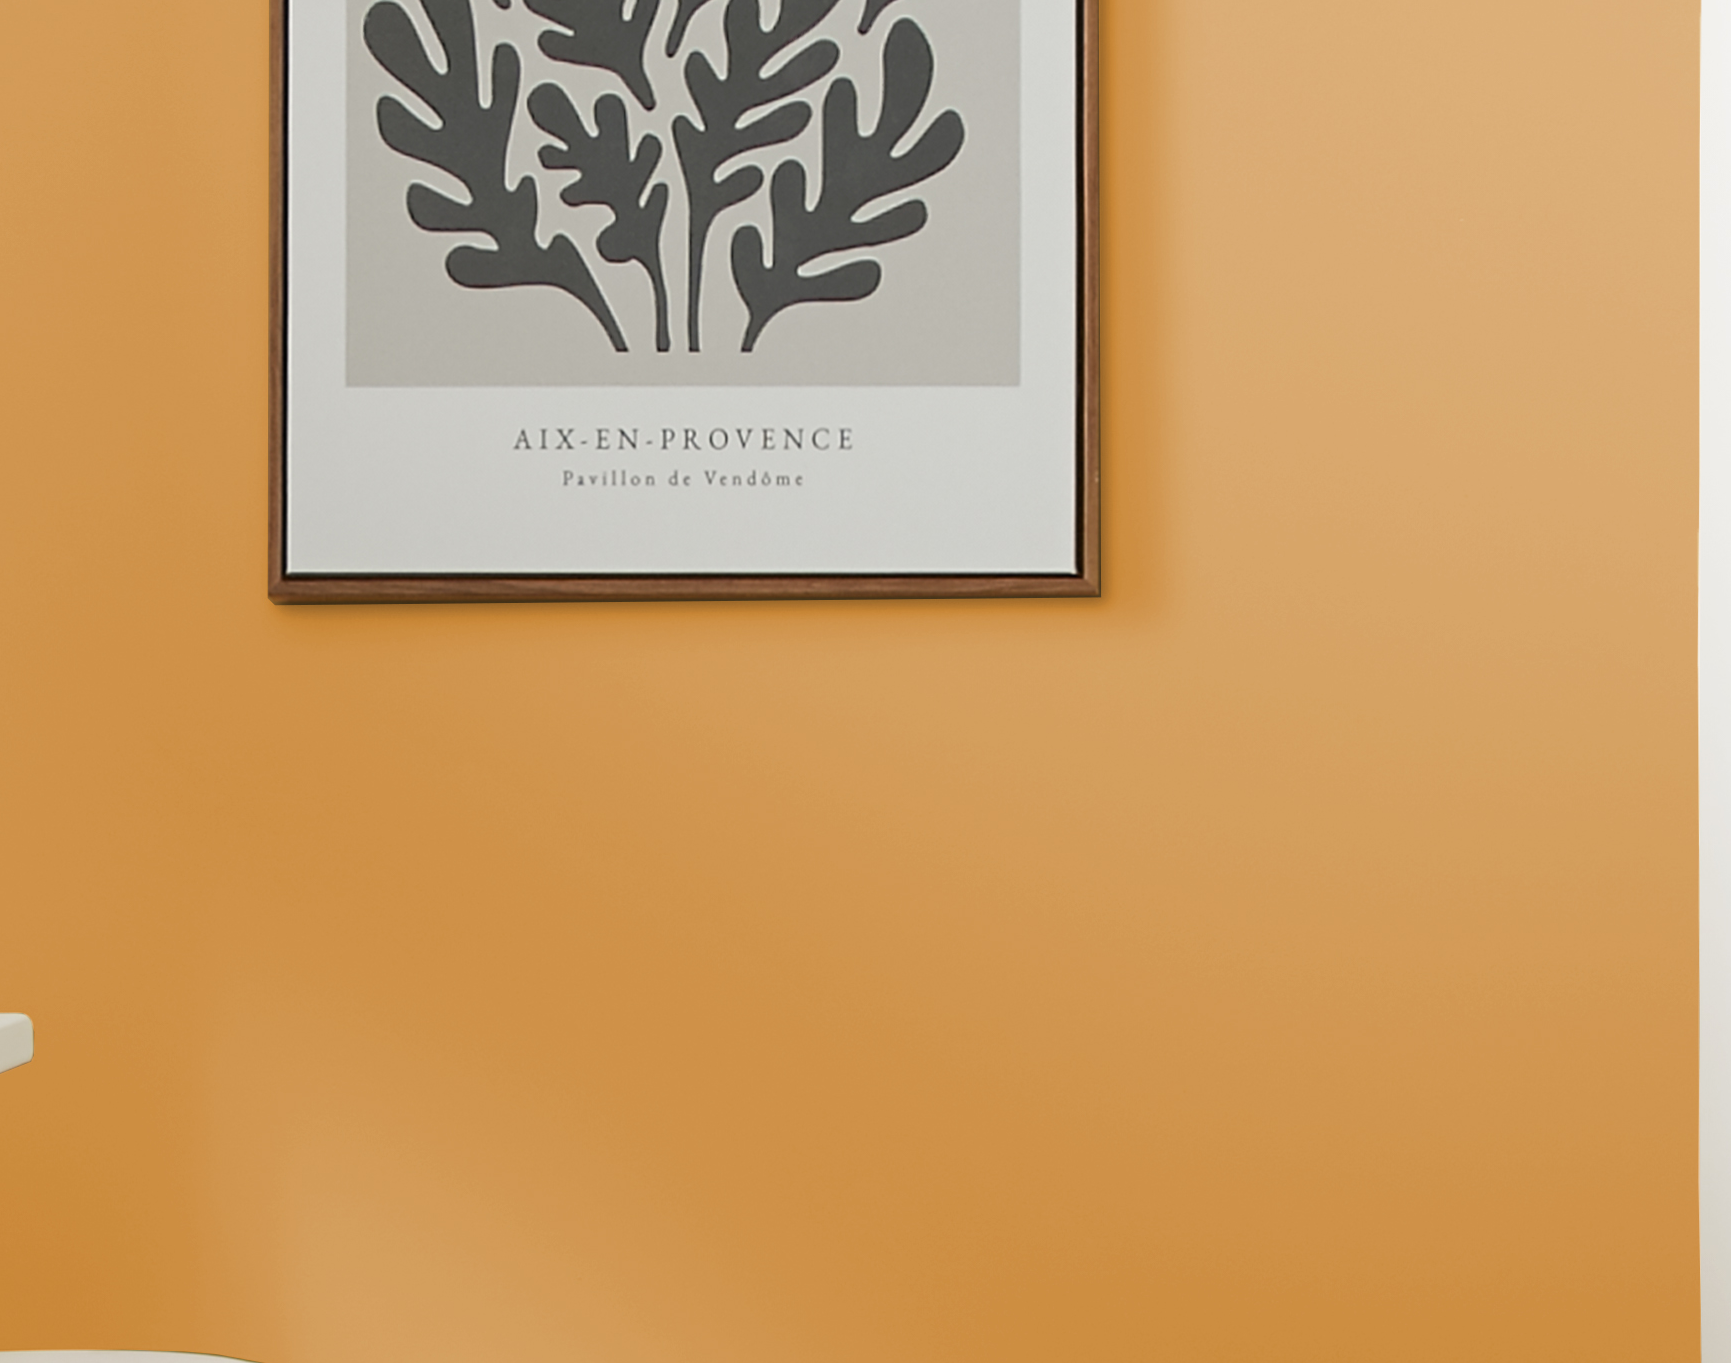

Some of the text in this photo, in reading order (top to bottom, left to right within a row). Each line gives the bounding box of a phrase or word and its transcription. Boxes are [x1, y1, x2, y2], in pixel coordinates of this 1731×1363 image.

[512, 427, 854, 451] AIX-EN-PROVENCE
[562, 469, 804, 487] Pavillon de Vendôme
